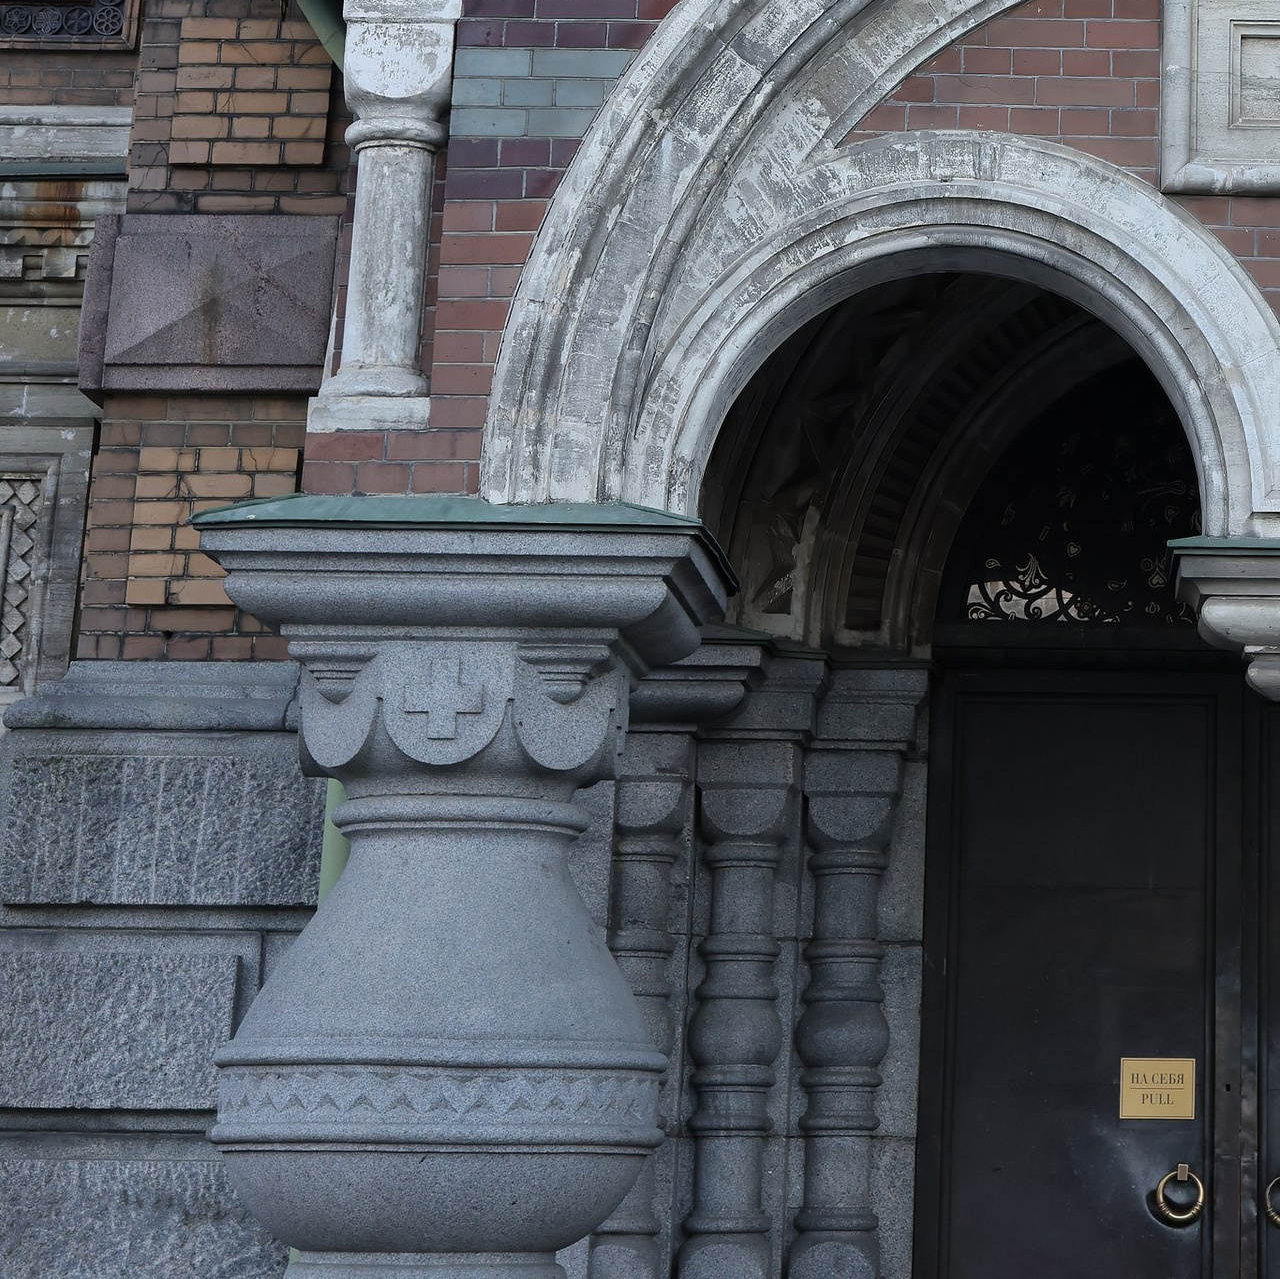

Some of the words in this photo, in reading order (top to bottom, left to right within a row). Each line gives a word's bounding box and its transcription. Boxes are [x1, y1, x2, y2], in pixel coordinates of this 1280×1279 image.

[1130, 1073, 1148, 1085] НА
[1151, 1073, 1185, 1085] СЕБЯ
[1141, 1093, 1174, 1105] PULL
